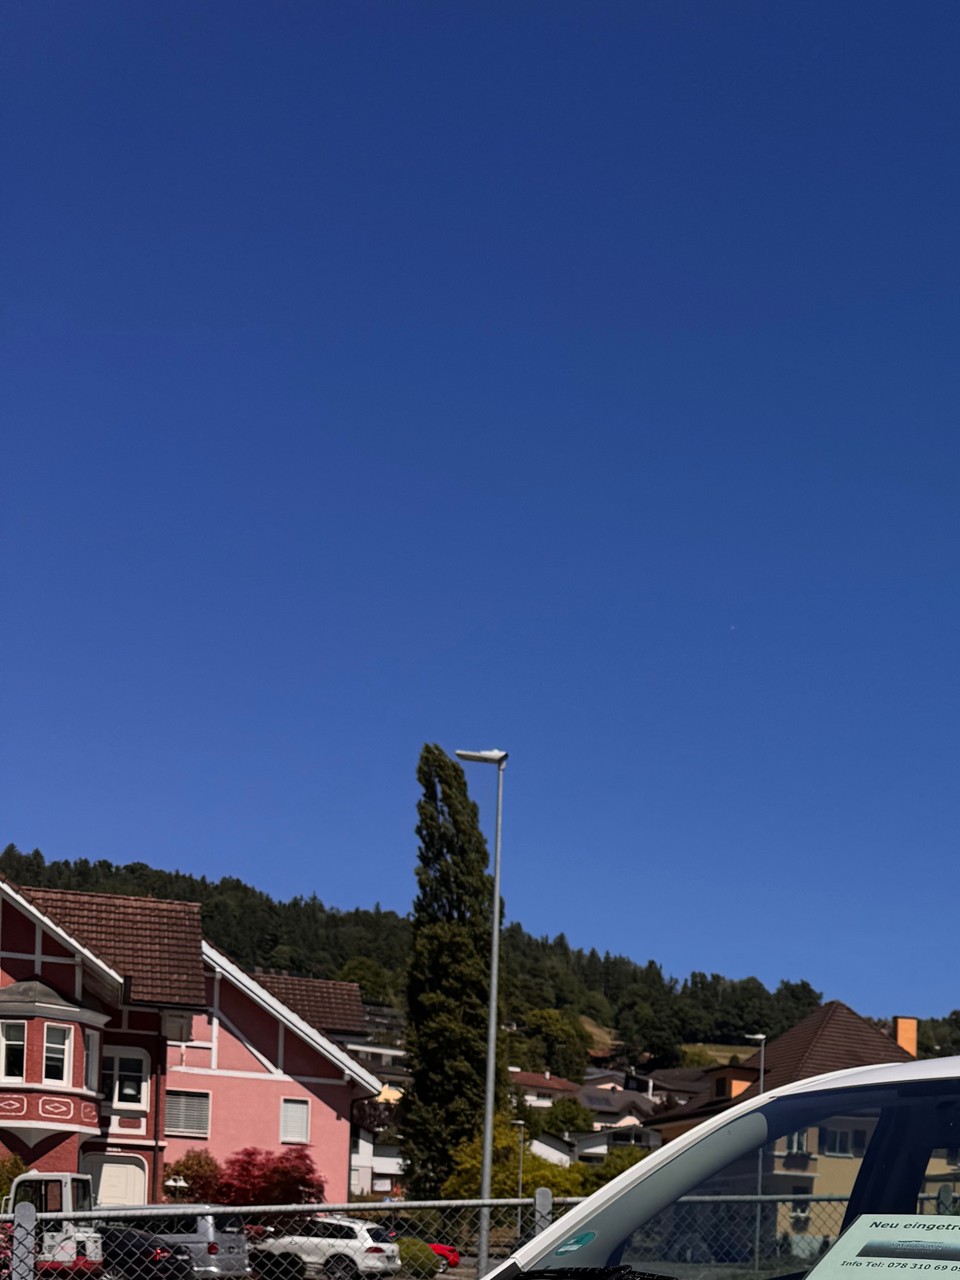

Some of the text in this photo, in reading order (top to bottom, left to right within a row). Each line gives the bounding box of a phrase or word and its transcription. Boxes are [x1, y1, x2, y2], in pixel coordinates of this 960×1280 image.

[869, 1221, 899, 1229] Neu
[840, 1260, 862, 1268] Info
[910, 1262, 931, 1270] 310
